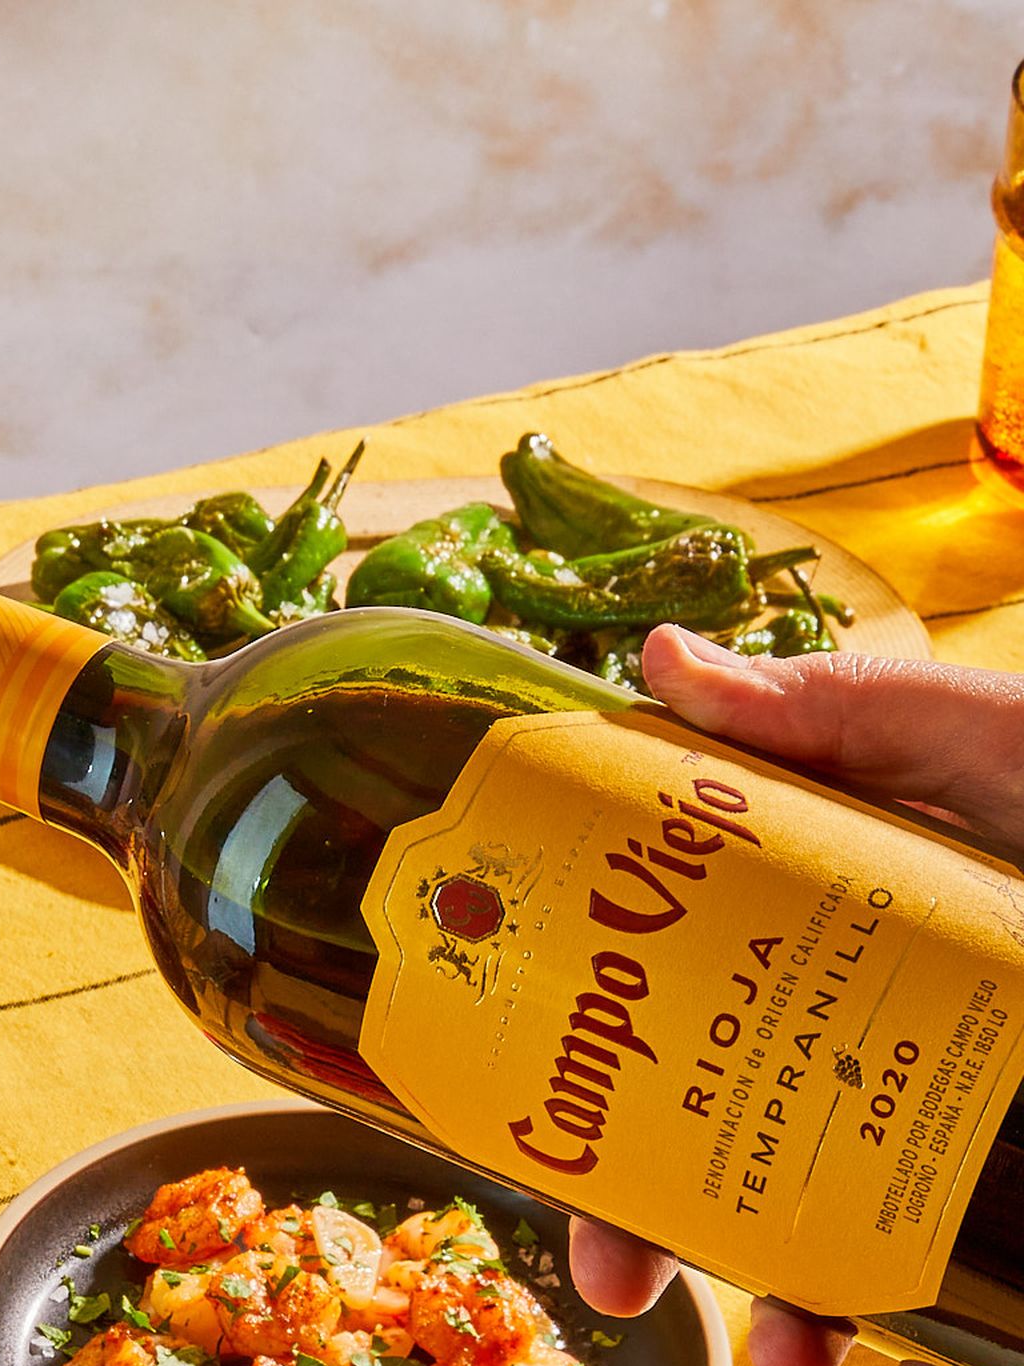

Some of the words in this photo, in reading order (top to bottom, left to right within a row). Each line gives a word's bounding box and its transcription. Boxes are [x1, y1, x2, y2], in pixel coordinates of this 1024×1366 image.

[508, 952, 658, 1174] Campo
[588, 779, 762, 934] Viejo
[682, 937, 784, 1117] RIOJA
[967, 979, 999, 1013] VIEJO
[703, 1075, 755, 1199] DENOMINACION
[744, 1048, 765, 1069] de
[756, 972, 799, 1040] ORIGEN
[790, 875, 854, 965] CALIFICADA
[737, 887, 893, 1215] TEMPRANILLO
[946, 1014, 979, 1058] CAMPO
[860, 1041, 919, 1146] 2020
[903, 1164, 937, 1224] LOGROÑO
[928, 1105, 964, 1155] ESPAÑA
[954, 1059, 985, 1094] N.R.E.
[973, 1027, 999, 1056] 1850
[987, 1009, 1008, 1027] LO
[906, 1120, 931, 1149] POR
[918, 1058, 957, 1120] BODEGAS
[875, 1149, 918, 1235] EMBOTELLADO
